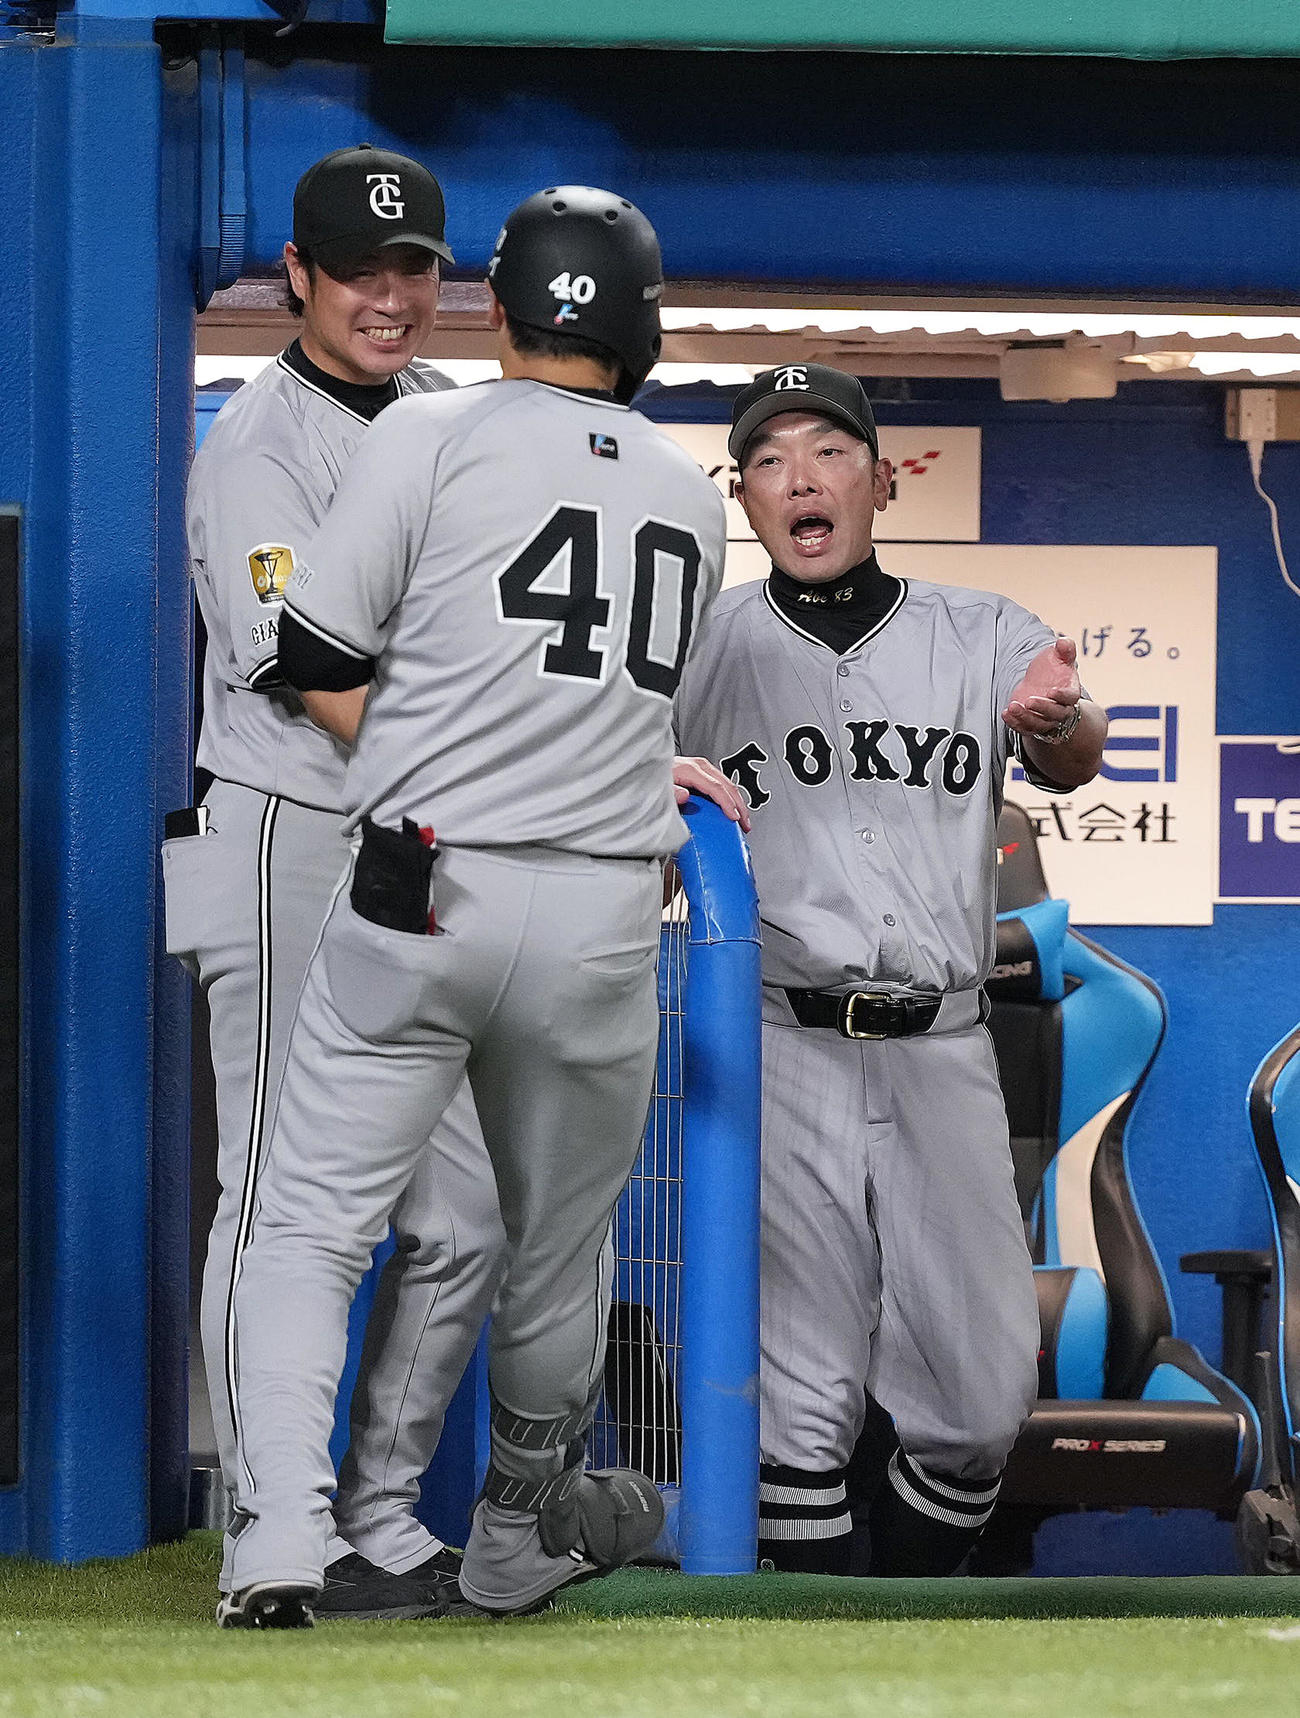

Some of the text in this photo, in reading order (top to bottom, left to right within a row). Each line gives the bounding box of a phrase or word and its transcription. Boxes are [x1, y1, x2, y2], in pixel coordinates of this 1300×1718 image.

[548, 271, 597, 305] 40
[492, 499, 703, 704] 40
[834, 587, 854, 602] 83
[720, 718, 982, 810] TOKYO
